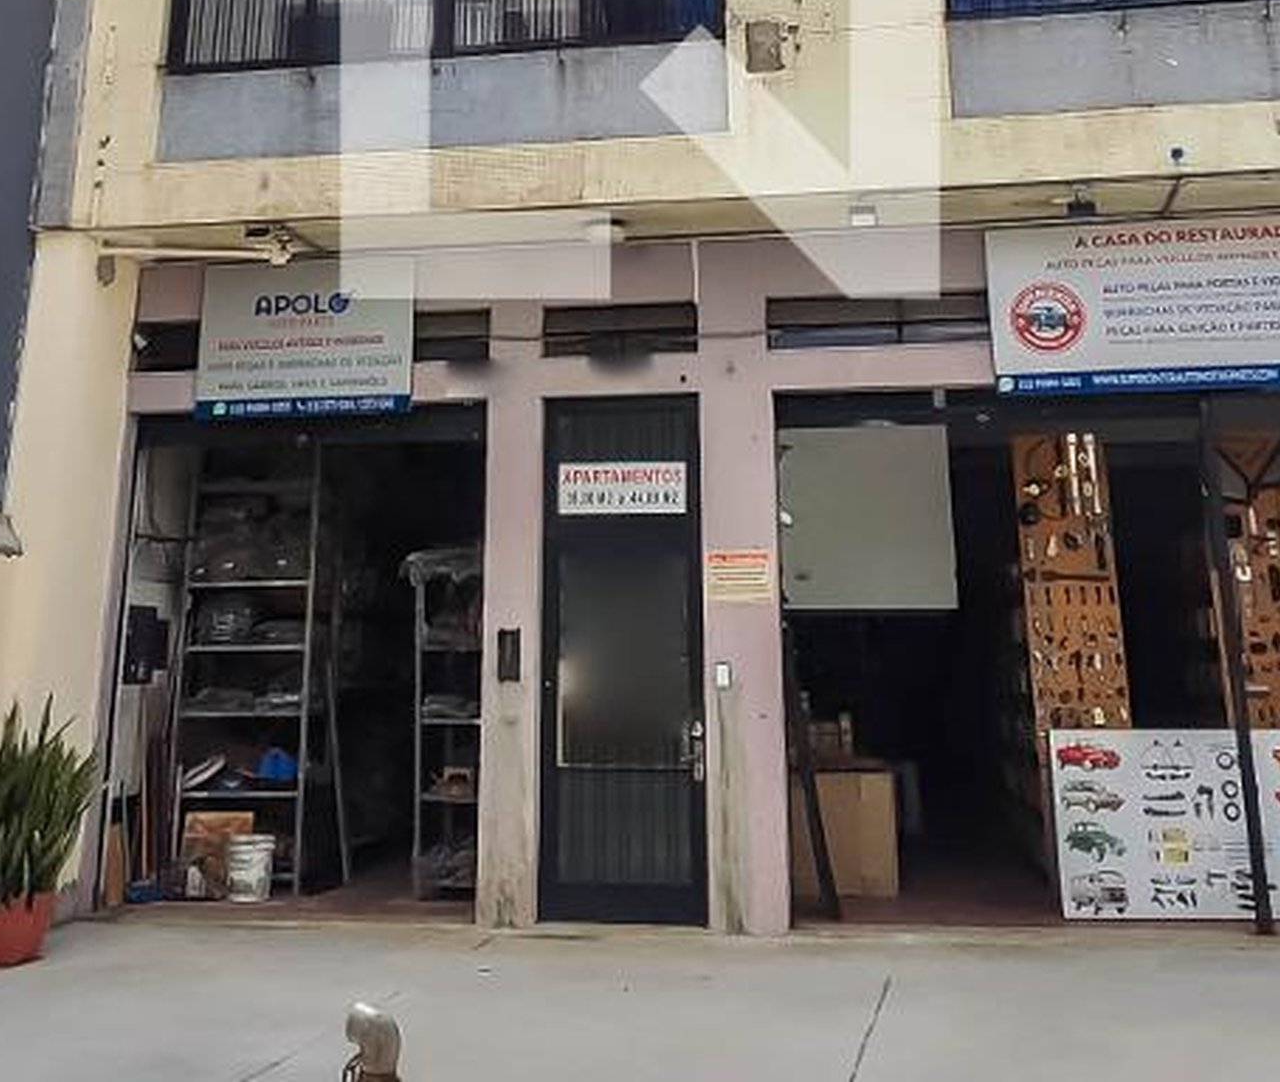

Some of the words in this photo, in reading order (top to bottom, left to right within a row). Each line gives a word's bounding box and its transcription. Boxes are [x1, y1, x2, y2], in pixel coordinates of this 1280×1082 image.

[1074, 235, 1086, 248] A
[1091, 233, 1141, 248] CASA
[1145, 231, 1171, 245] DO
[1103, 283, 1135, 294] AUTO
[1174, 280, 1202, 291] PARA
[1207, 278, 1250, 289] PORTAS
[254, 292, 352, 316] APOLO
[1144, 323, 1175, 334] PARA
[562, 469, 681, 485] APARTAMENTOS
